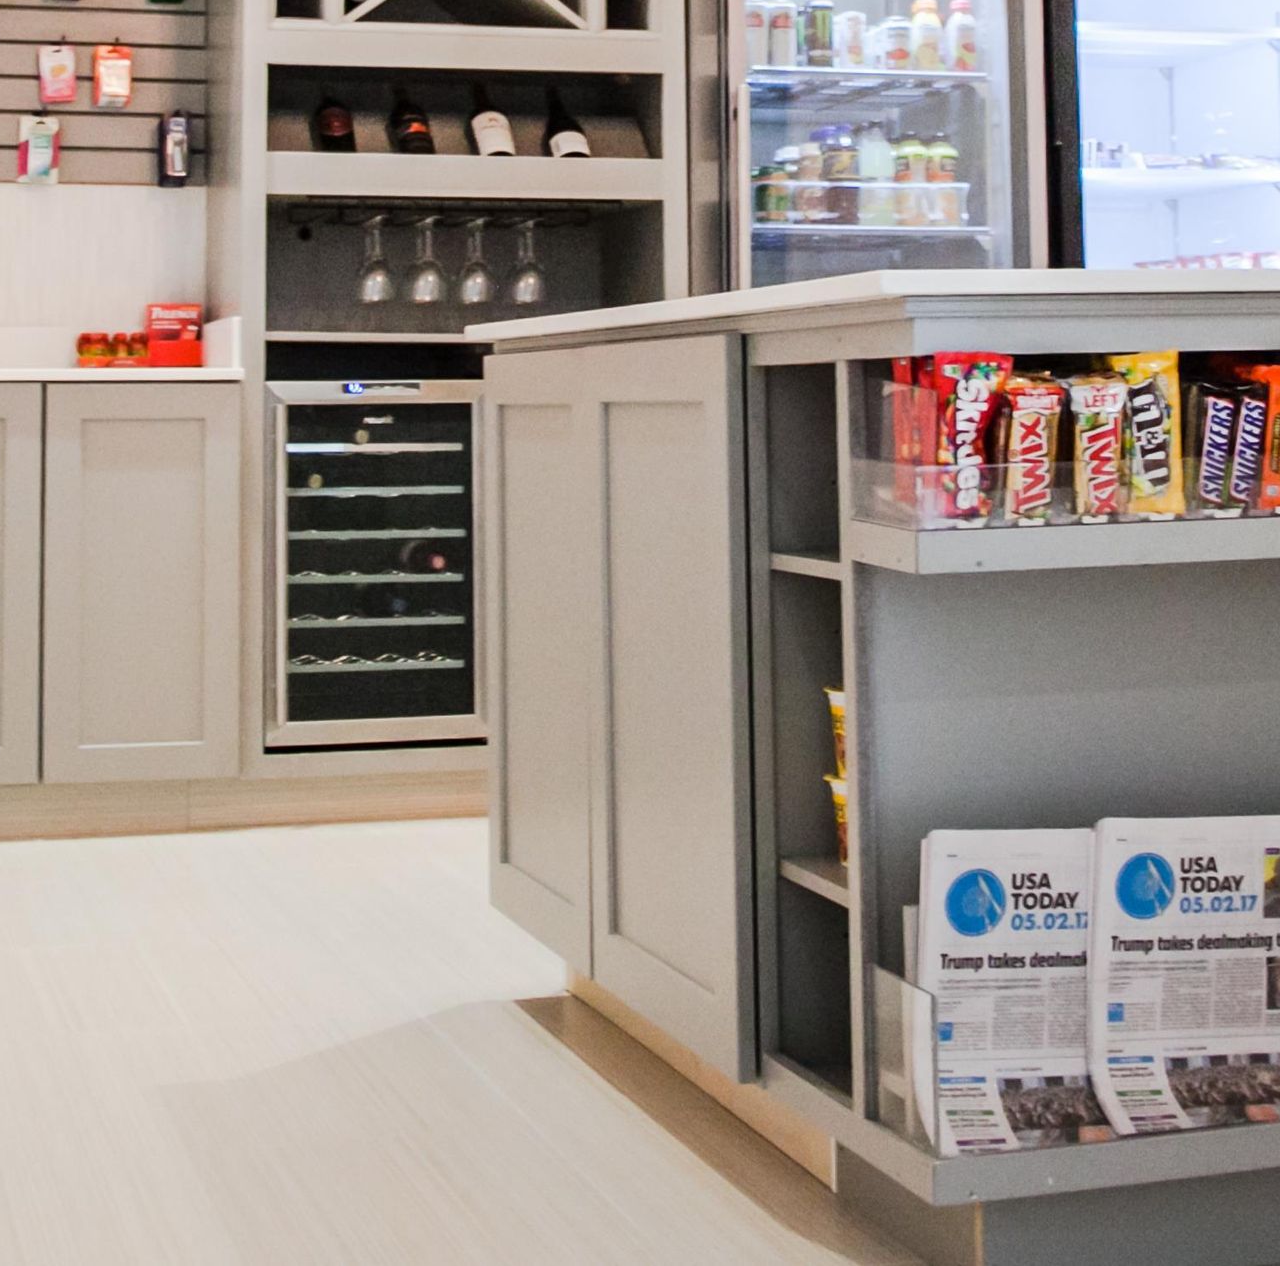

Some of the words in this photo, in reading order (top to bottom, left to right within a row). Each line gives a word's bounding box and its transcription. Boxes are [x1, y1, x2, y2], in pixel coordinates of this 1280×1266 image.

[1084, 394, 1118, 408] LEFT
[1202, 401, 1234, 500] SNICKERS
[1232, 401, 1266, 498] SNICKERS
[1012, 416, 1049, 515] TWIX
[1086, 417, 1120, 515] TWIX
[1180, 856, 1218, 874] USA
[1011, 872, 1052, 890] USA
[1180, 876, 1245, 894] TODAY
[1011, 892, 1079, 910] TODAY
[1179, 895, 1258, 914] 05.02.17
[1111, 936, 1154, 955] Trump
[1158, 935, 1194, 951] takes
[1197, 934, 1273, 951] dealmaking
[940, 953, 984, 972] Trump
[988, 952, 1026, 968] takes
